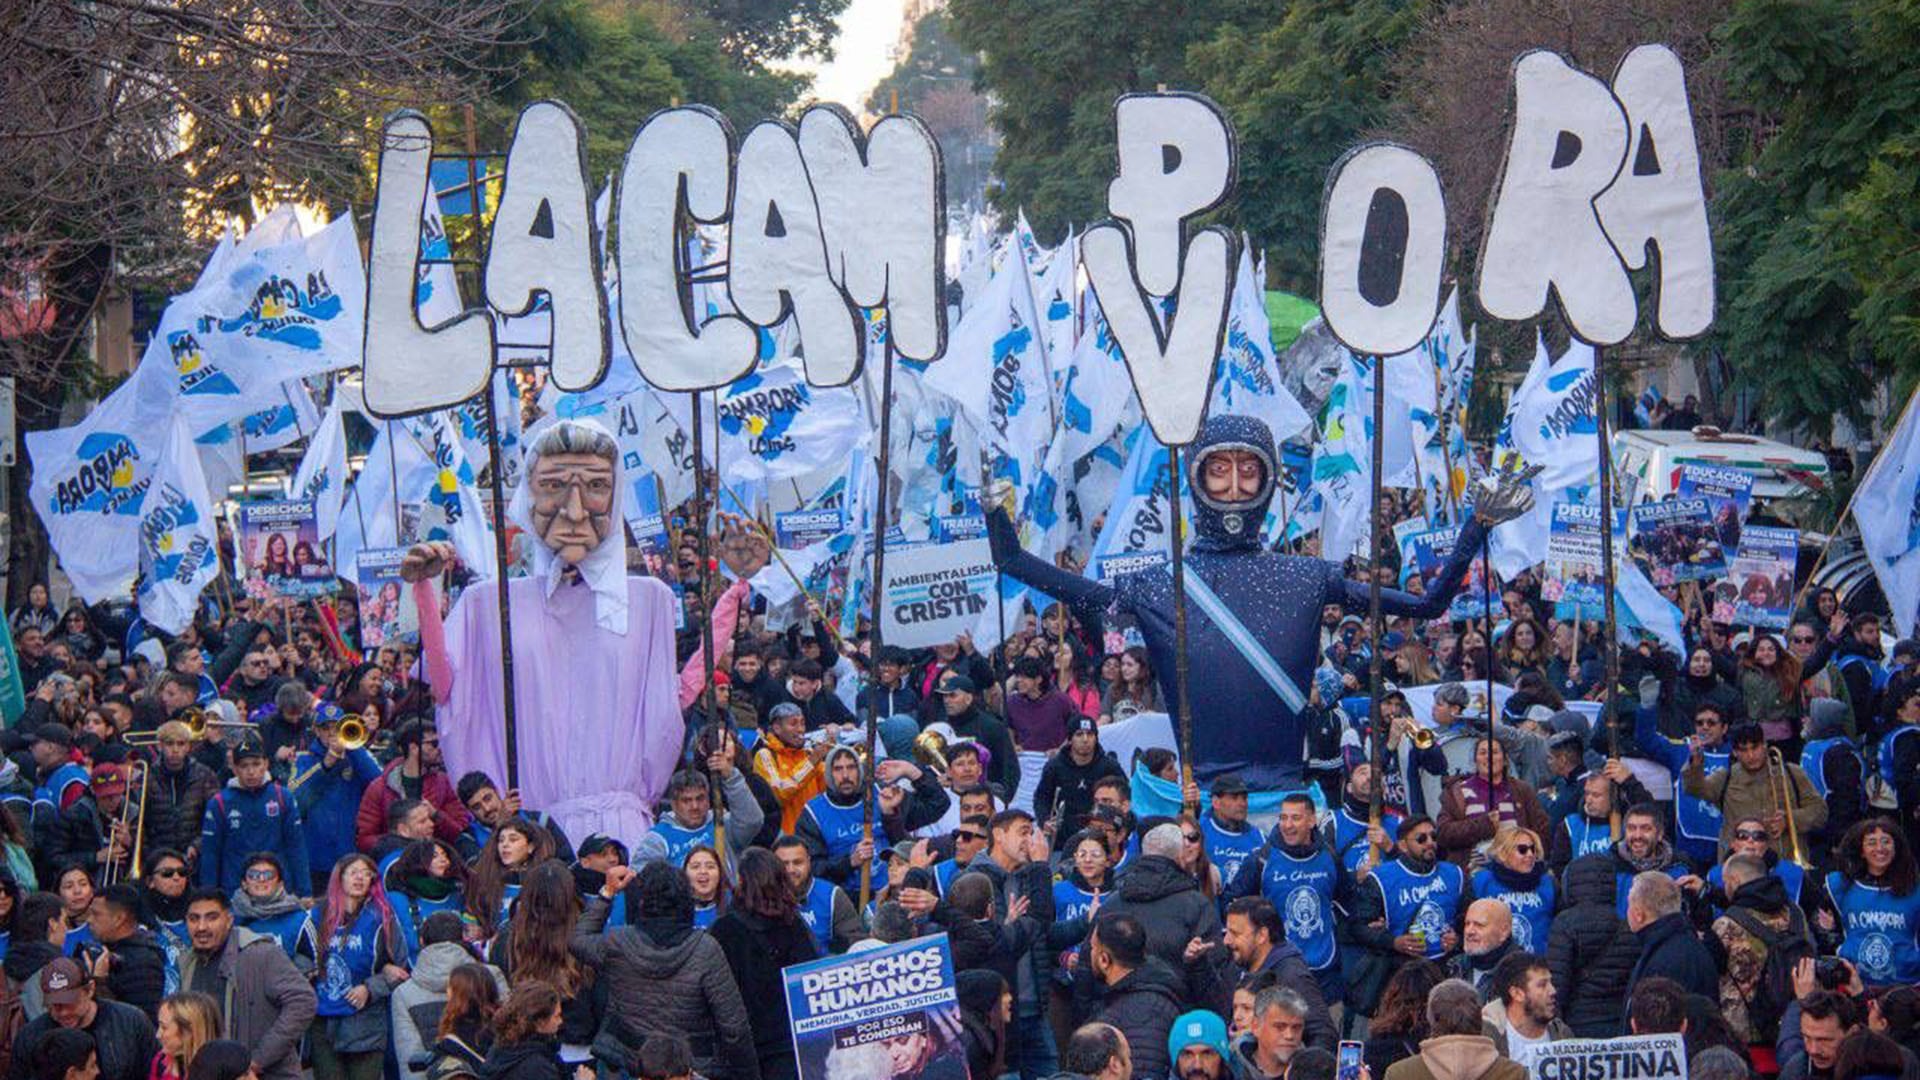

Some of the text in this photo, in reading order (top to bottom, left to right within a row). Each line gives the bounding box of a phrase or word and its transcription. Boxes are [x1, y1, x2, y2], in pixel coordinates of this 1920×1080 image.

[247, 503, 313, 517] DERECHOS
[780, 513, 840, 527] DERECHOS
[928, 579, 969, 599] CON
[894, 594, 988, 626] CRISTIN
[1273, 869, 1287, 882] La
[801, 945, 943, 995] DERECHOS
[808, 968, 943, 1015] HUMANOS
[800, 1012, 855, 1030] MEMORIA,
[904, 991, 951, 1008] JUSTICIA
[841, 1021, 923, 1047] TE CONDENAN
[856, 1015, 906, 1034] POR ESO
[1536, 1038, 1678, 1056] LA MATANZA SIEMPRE CON
[1539, 1050, 1681, 1080] CRISTINA
